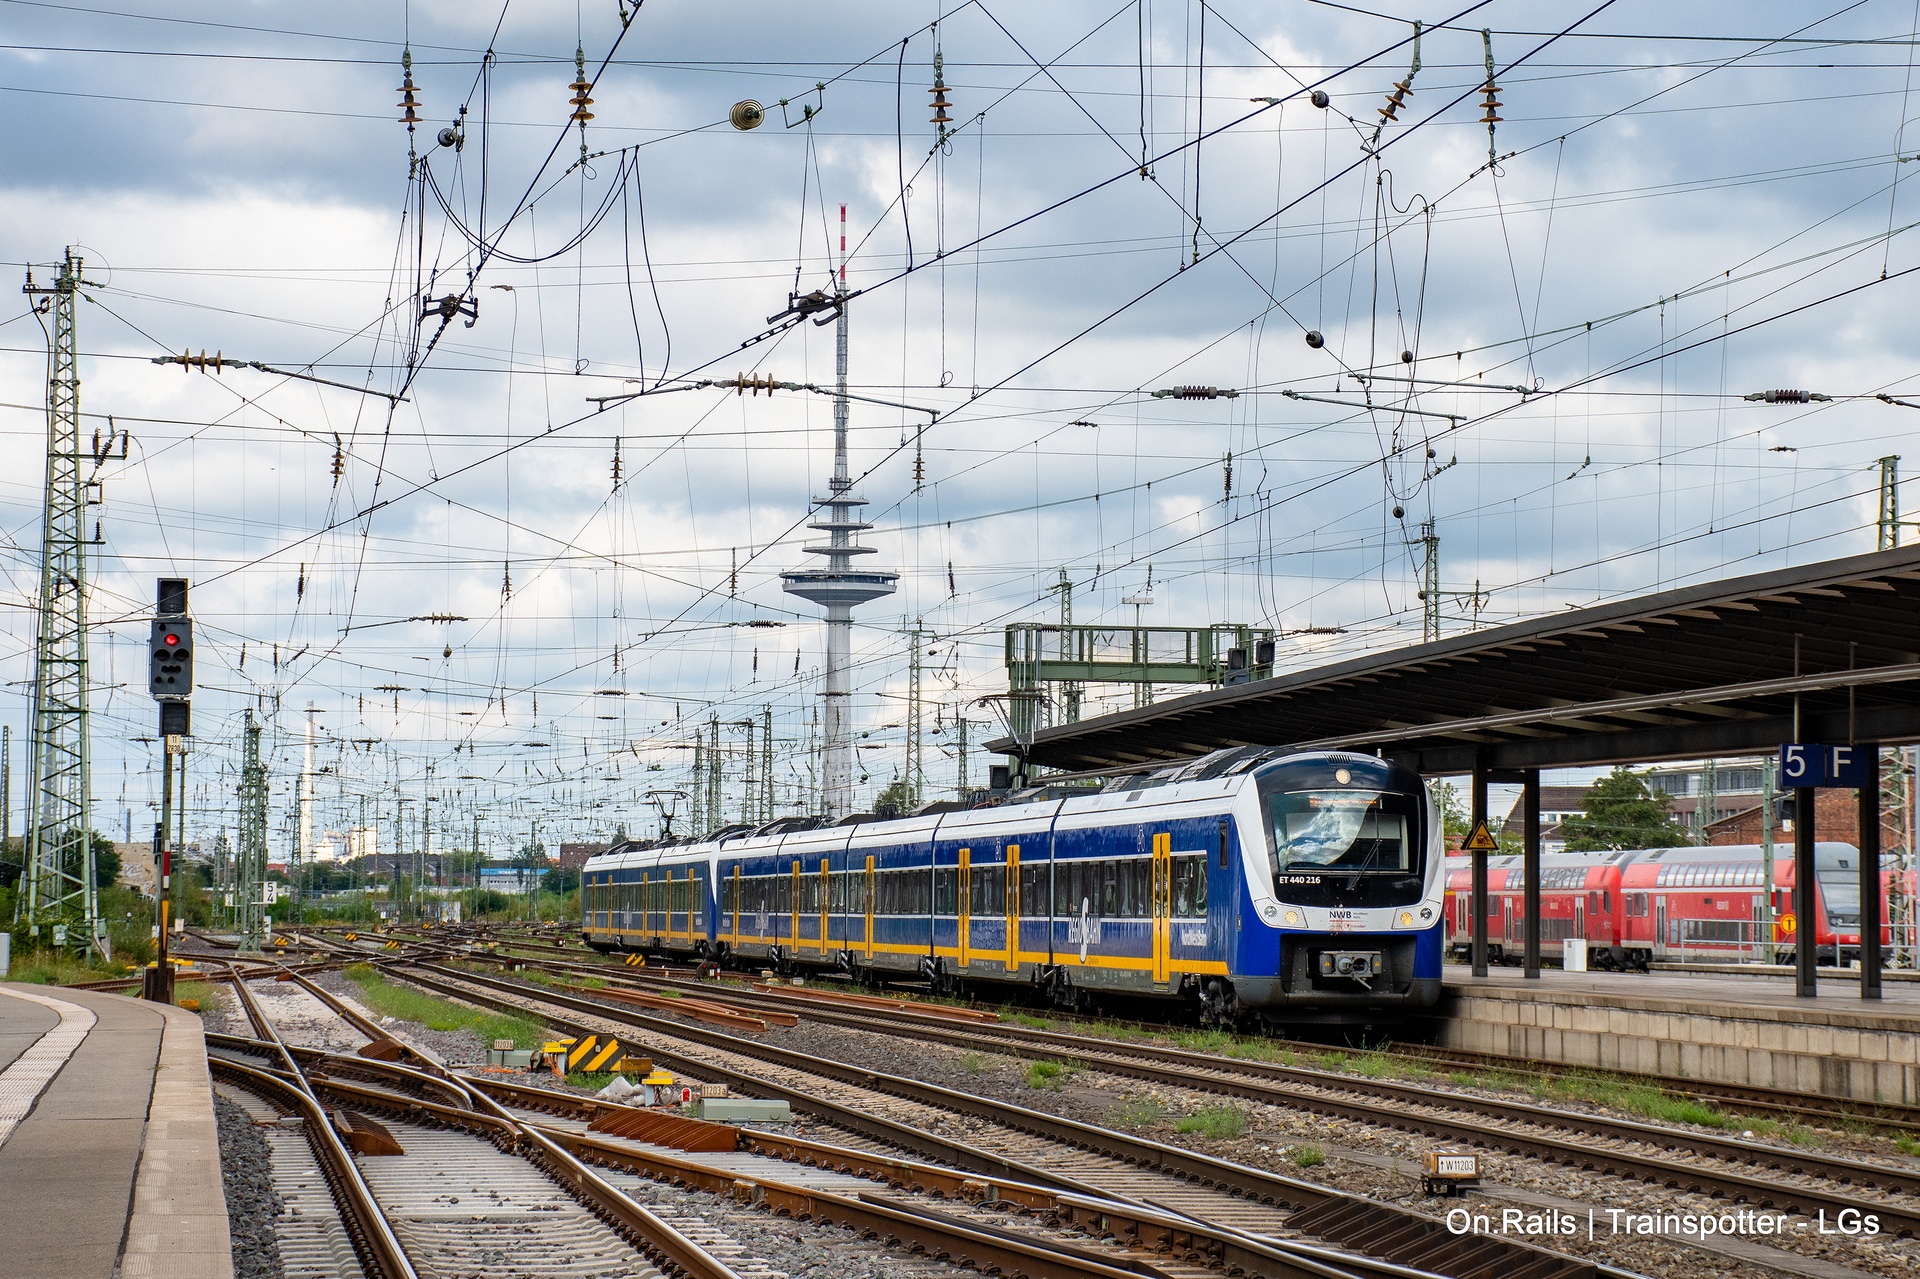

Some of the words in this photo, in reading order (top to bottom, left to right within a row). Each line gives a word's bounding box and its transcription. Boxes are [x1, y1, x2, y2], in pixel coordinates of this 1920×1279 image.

[171, 735, 177, 743] 11
[1785, 745, 1806, 777] 5
[1833, 746, 1853, 778] F
[1279, 876, 1289, 884] ET
[1290, 876, 1305, 884] 440
[1306, 876, 1321, 884] 216
[267, 882, 274, 892] 5
[267, 893, 274, 902] 4
[1329, 910, 1352, 919] NWB
[702, 1085, 726, 1095] 11203a
[1445, 1160, 1474, 1171] W11203
